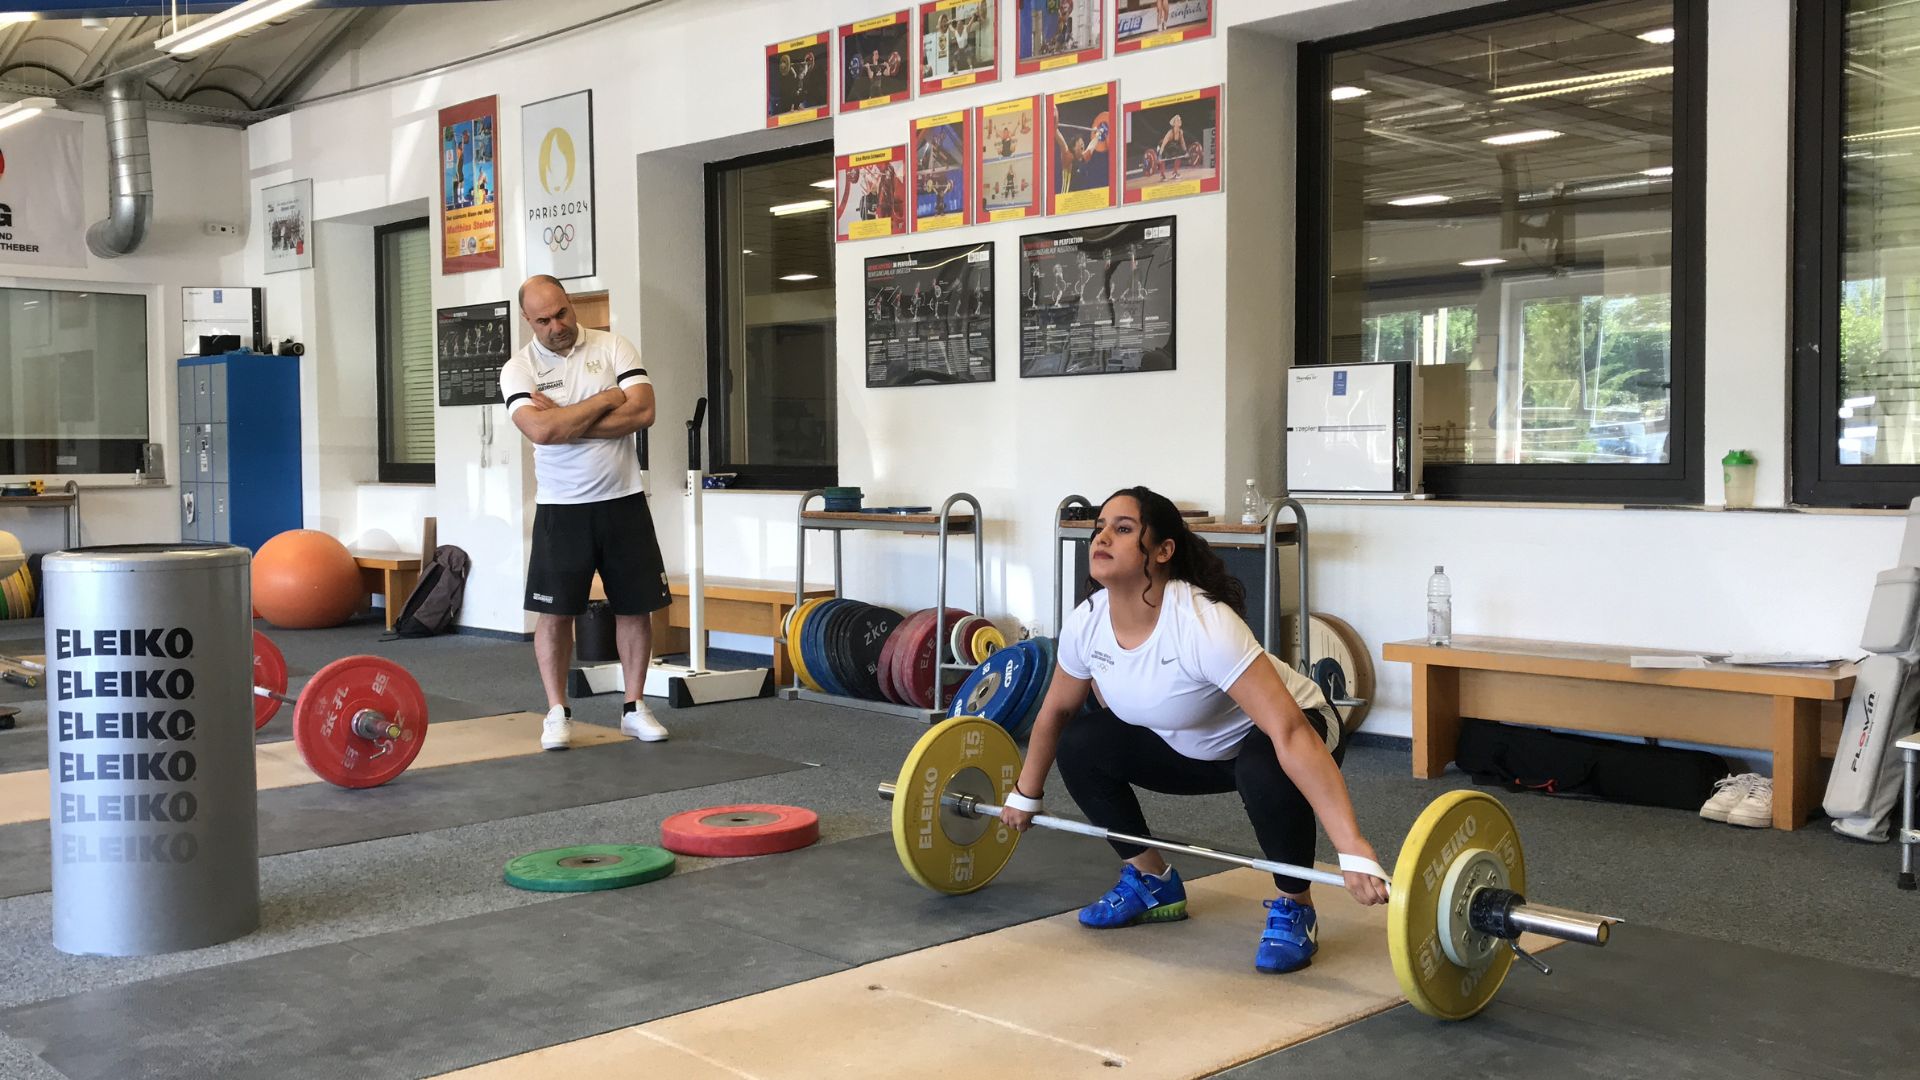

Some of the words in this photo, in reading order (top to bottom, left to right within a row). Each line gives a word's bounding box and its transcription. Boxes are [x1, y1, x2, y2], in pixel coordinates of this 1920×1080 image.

[560, 200, 588, 216] 2024
[447, 223, 472, 233] Matthias
[473, 220, 495, 230] Steiner
[56, 627, 194, 660] ELEIKO
[863, 621, 889, 646] ZKC
[57, 668, 195, 701] ELEIKO
[371, 672, 388, 695] 25
[58, 709, 196, 742] ELEIKO
[965, 730, 981, 760] 15
[59, 750, 197, 783] ELEIKO
[60, 791, 198, 824] ELEIKO
[919, 767, 938, 850] ELEIKO
[61, 831, 199, 865] ELEIKO
[1422, 814, 1478, 893] ELEIKO
[955, 852, 973, 883] 15
